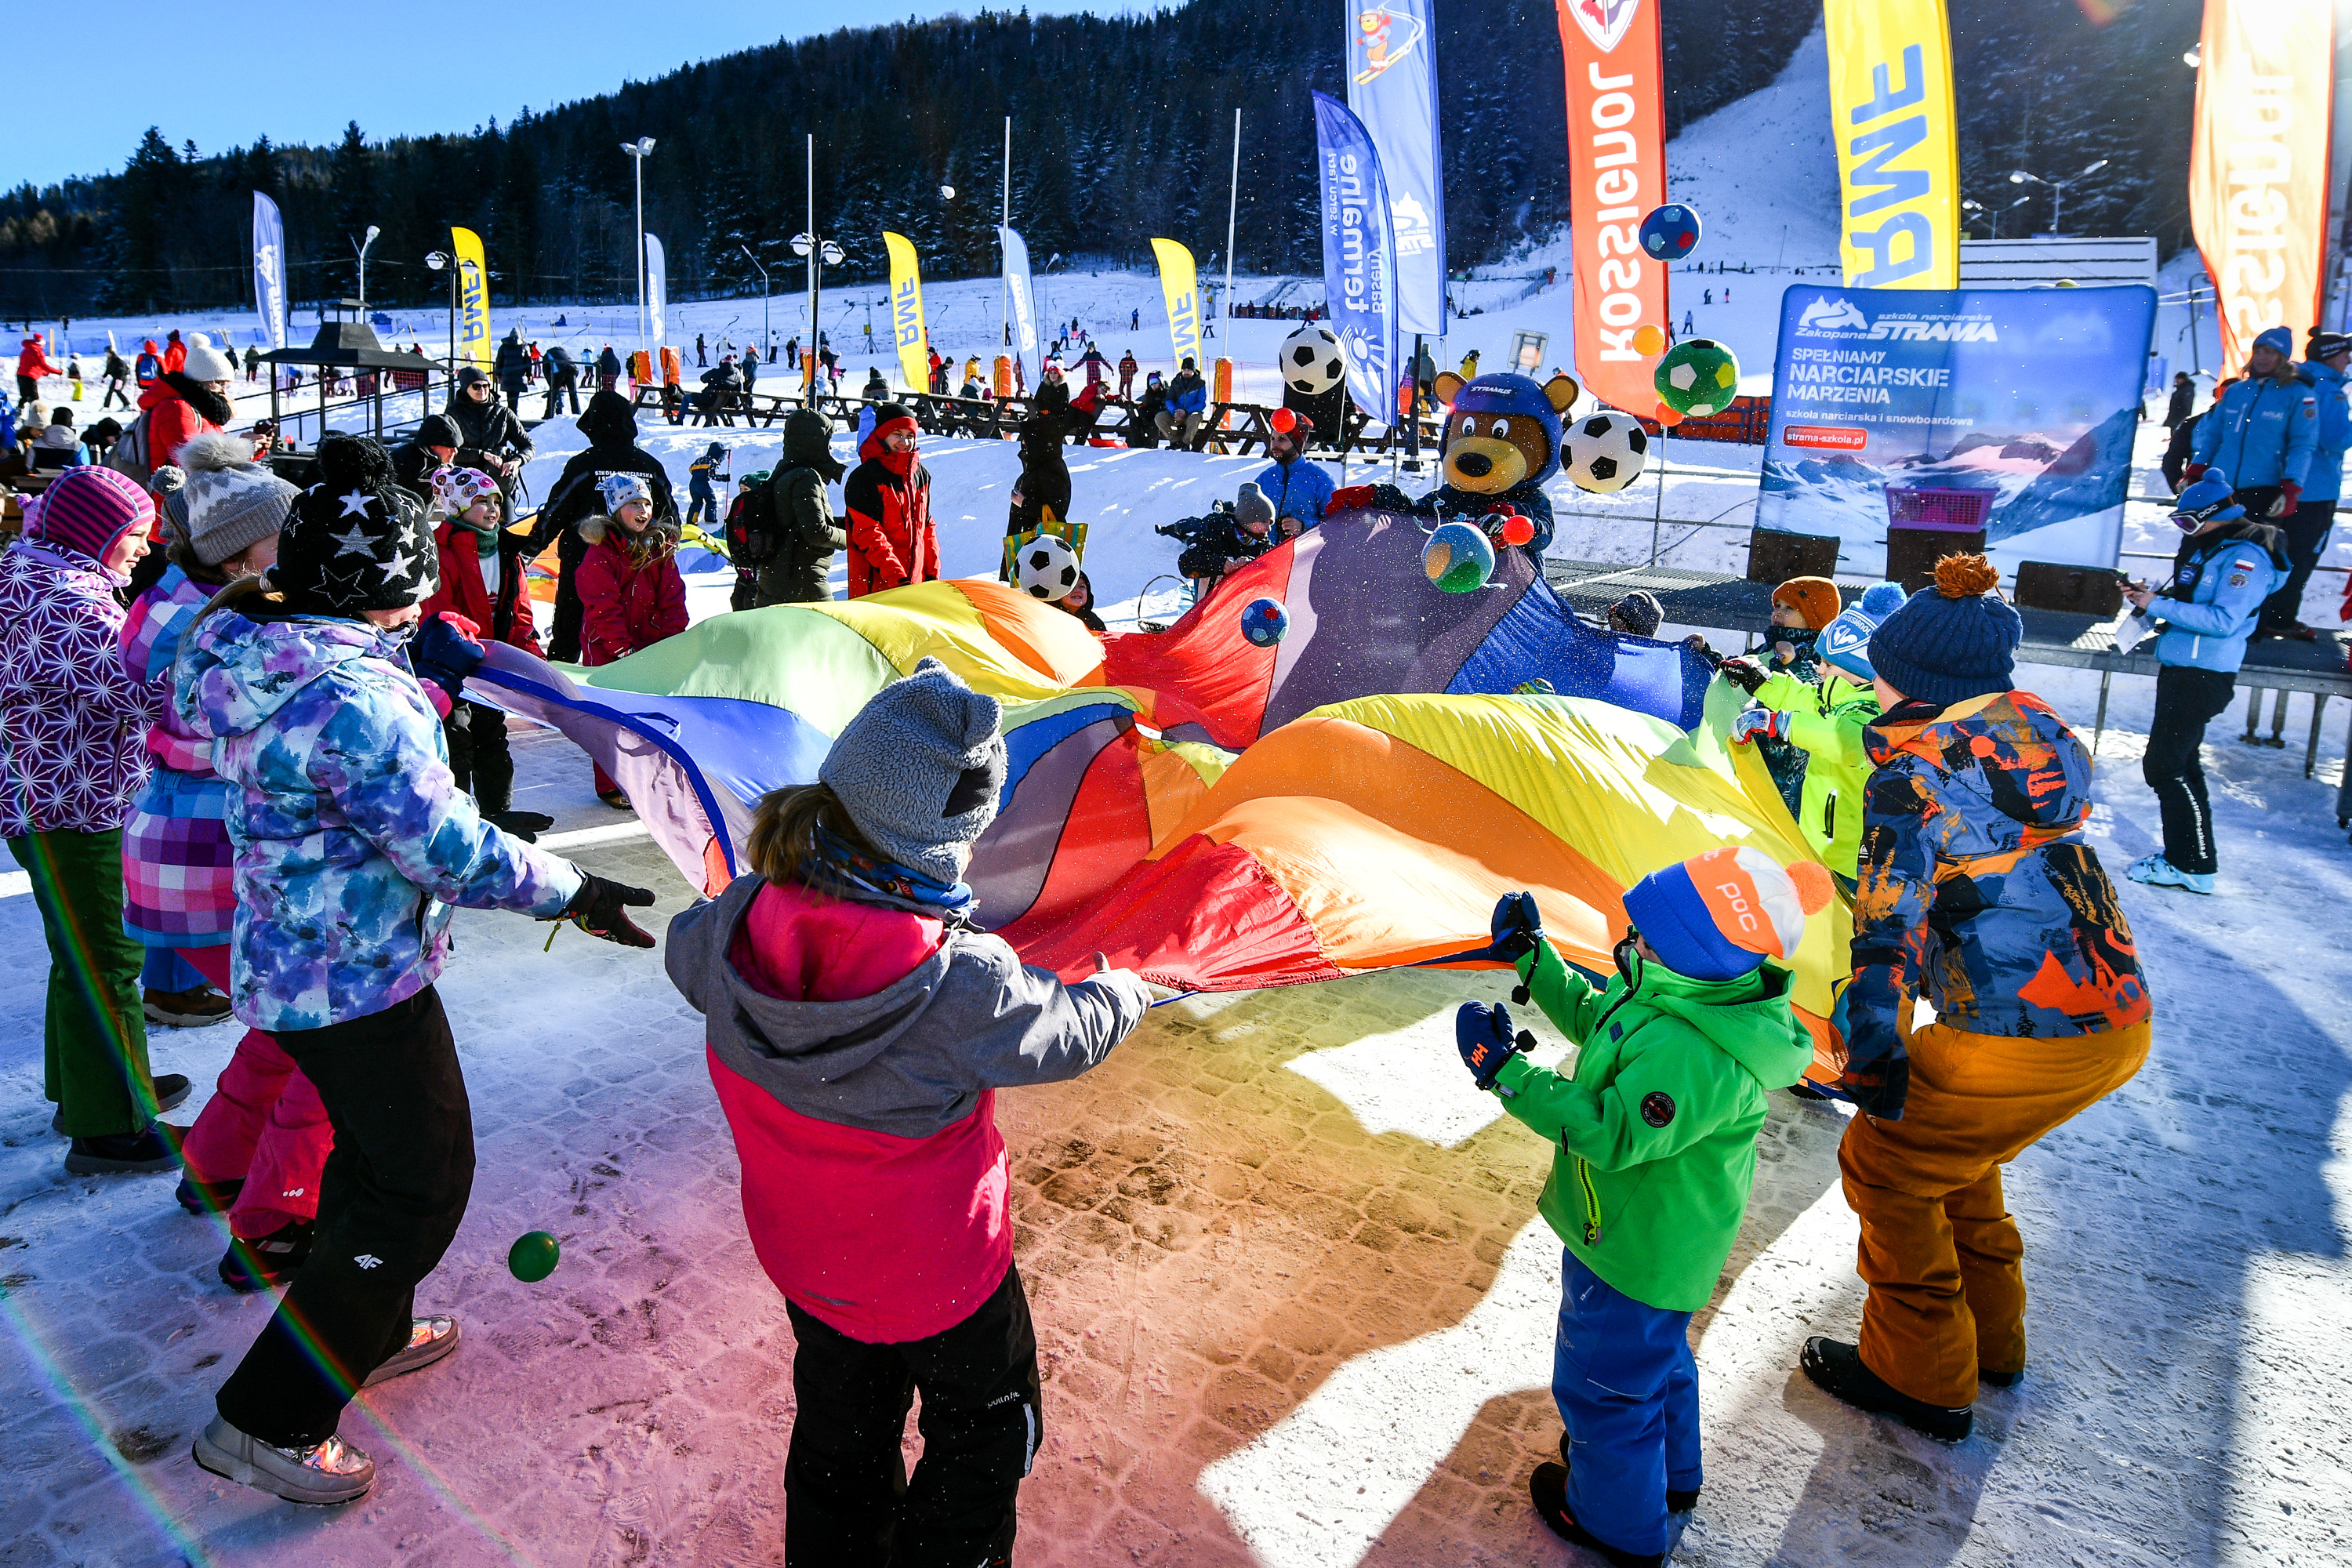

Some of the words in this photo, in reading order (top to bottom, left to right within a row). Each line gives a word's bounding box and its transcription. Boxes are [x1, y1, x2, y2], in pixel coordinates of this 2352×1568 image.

[1795, 327, 1867, 340] Zakopane
[1867, 321, 1999, 343] STRAMA
[1792, 347, 1887, 365] SPEŁNIAMY
[1789, 363, 1951, 387] NARCIARSKIE
[1787, 383, 1891, 404] MARZENIA
[1821, 412, 1877, 423] narciarska
[1886, 414, 1974, 426] snowboardowa
[1787, 432, 1864, 445] strama-szkola.pl
[1841, 614, 1871, 636] ROSSIGNOL
[1471, 1043, 1489, 1068] HH
[354, 1254, 383, 1270] 4F
